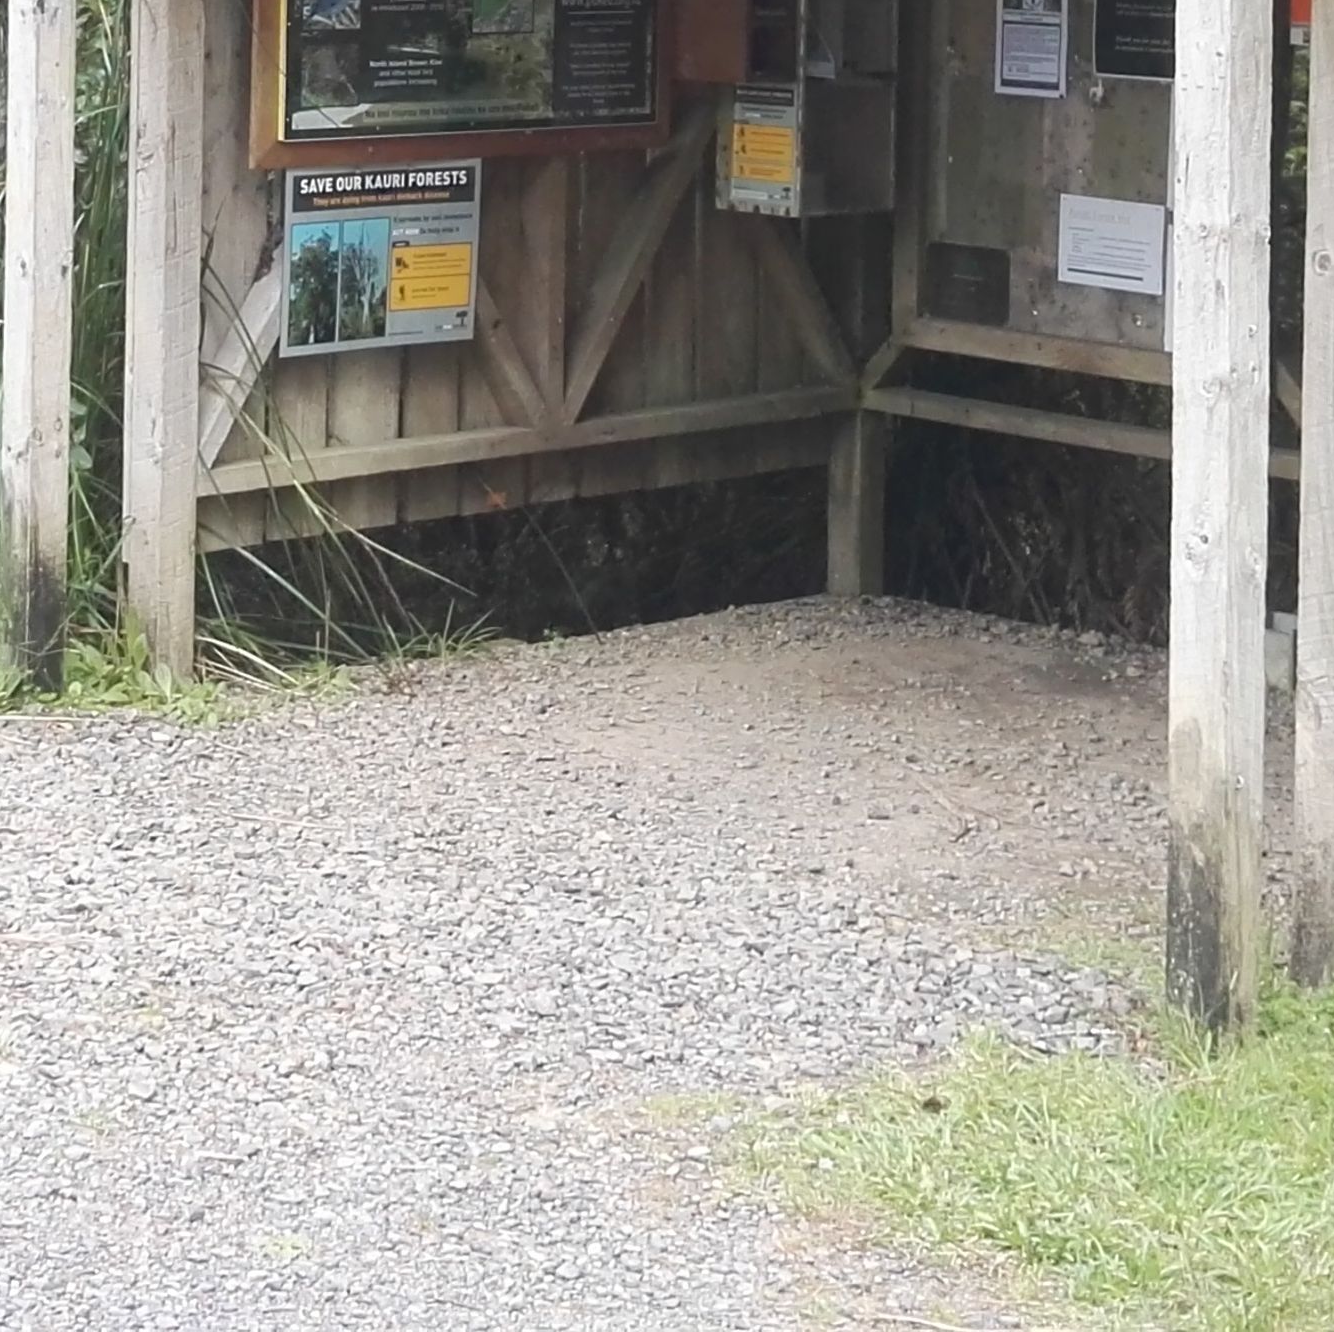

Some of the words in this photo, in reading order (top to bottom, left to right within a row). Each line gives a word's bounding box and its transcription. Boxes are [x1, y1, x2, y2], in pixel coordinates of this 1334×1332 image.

[300, 177, 334, 195] SAVE
[336, 175, 362, 192] OUR
[365, 172, 405, 189] KAURI
[408, 170, 468, 187] FORESTS
